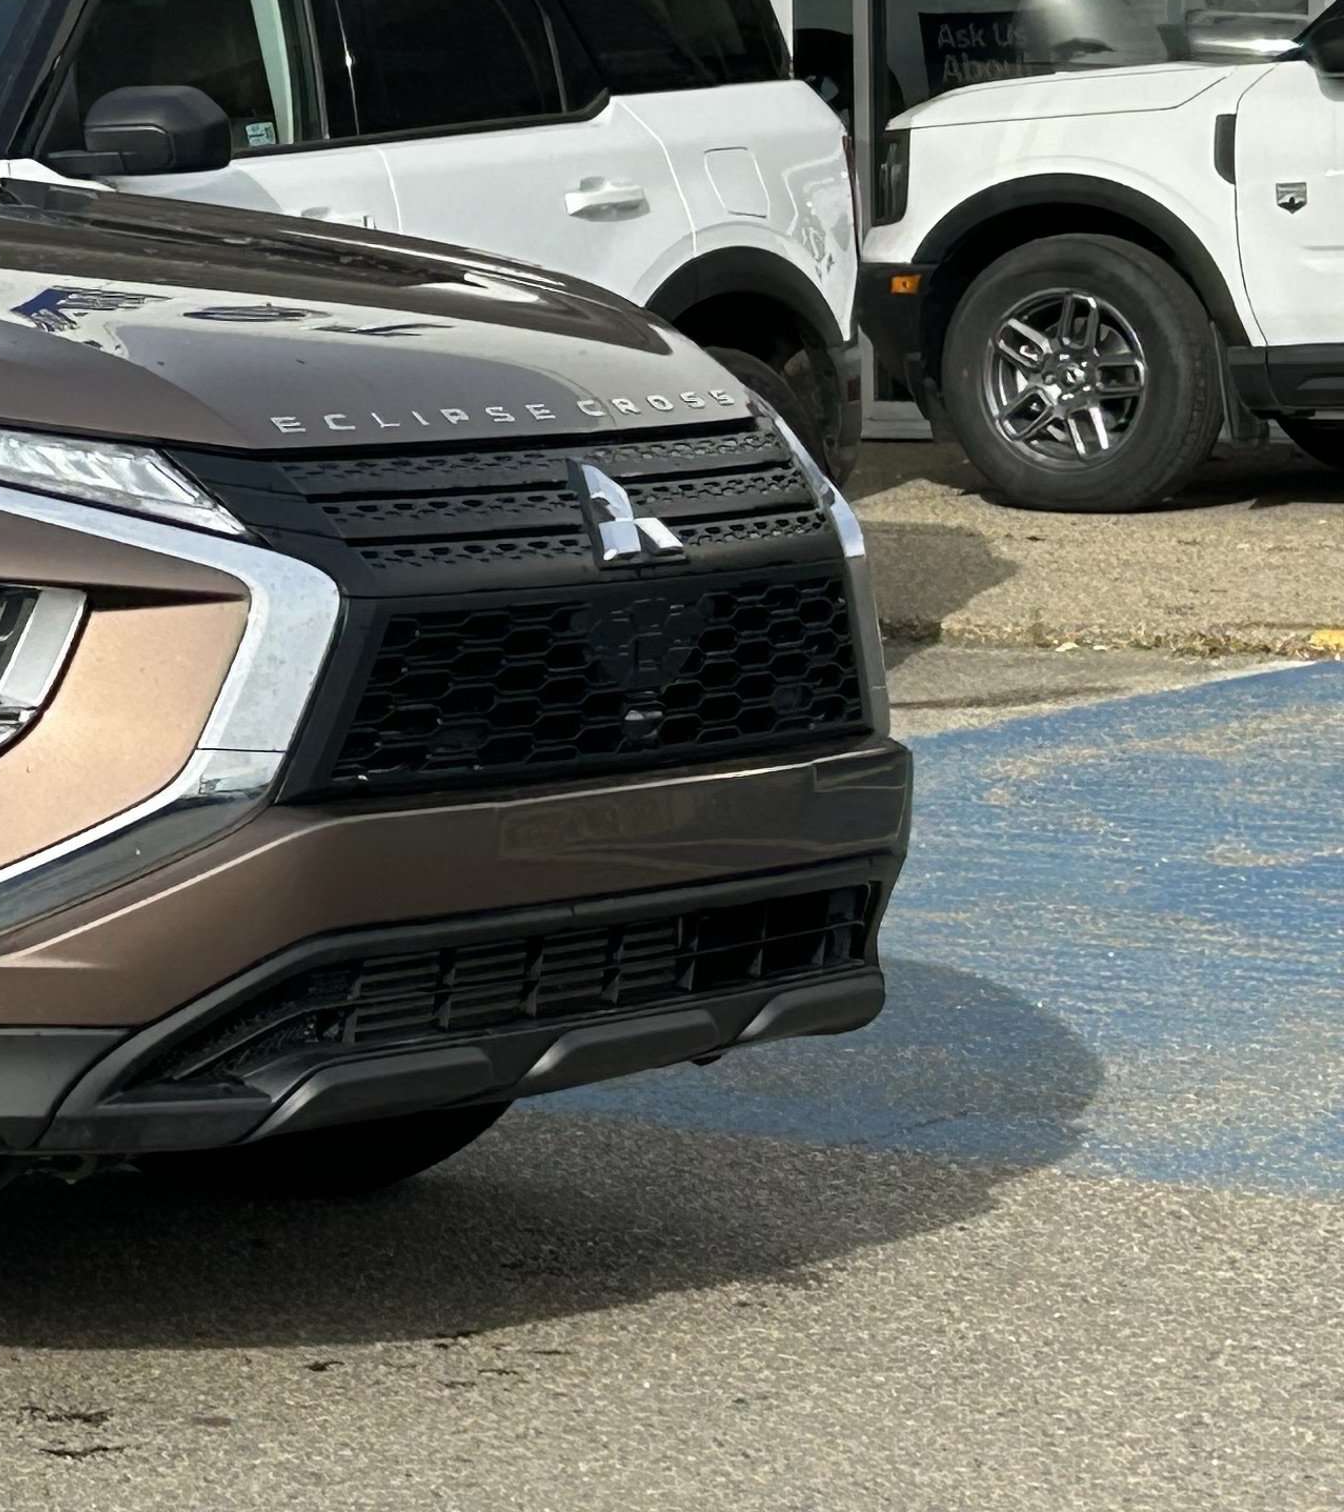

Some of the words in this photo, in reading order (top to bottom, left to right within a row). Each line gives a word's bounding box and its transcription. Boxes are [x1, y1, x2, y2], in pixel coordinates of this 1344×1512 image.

[937, 23, 987, 49] Ask
[270, 402, 556, 433] ECLIPSE
[576, 389, 736, 418] CROSS
